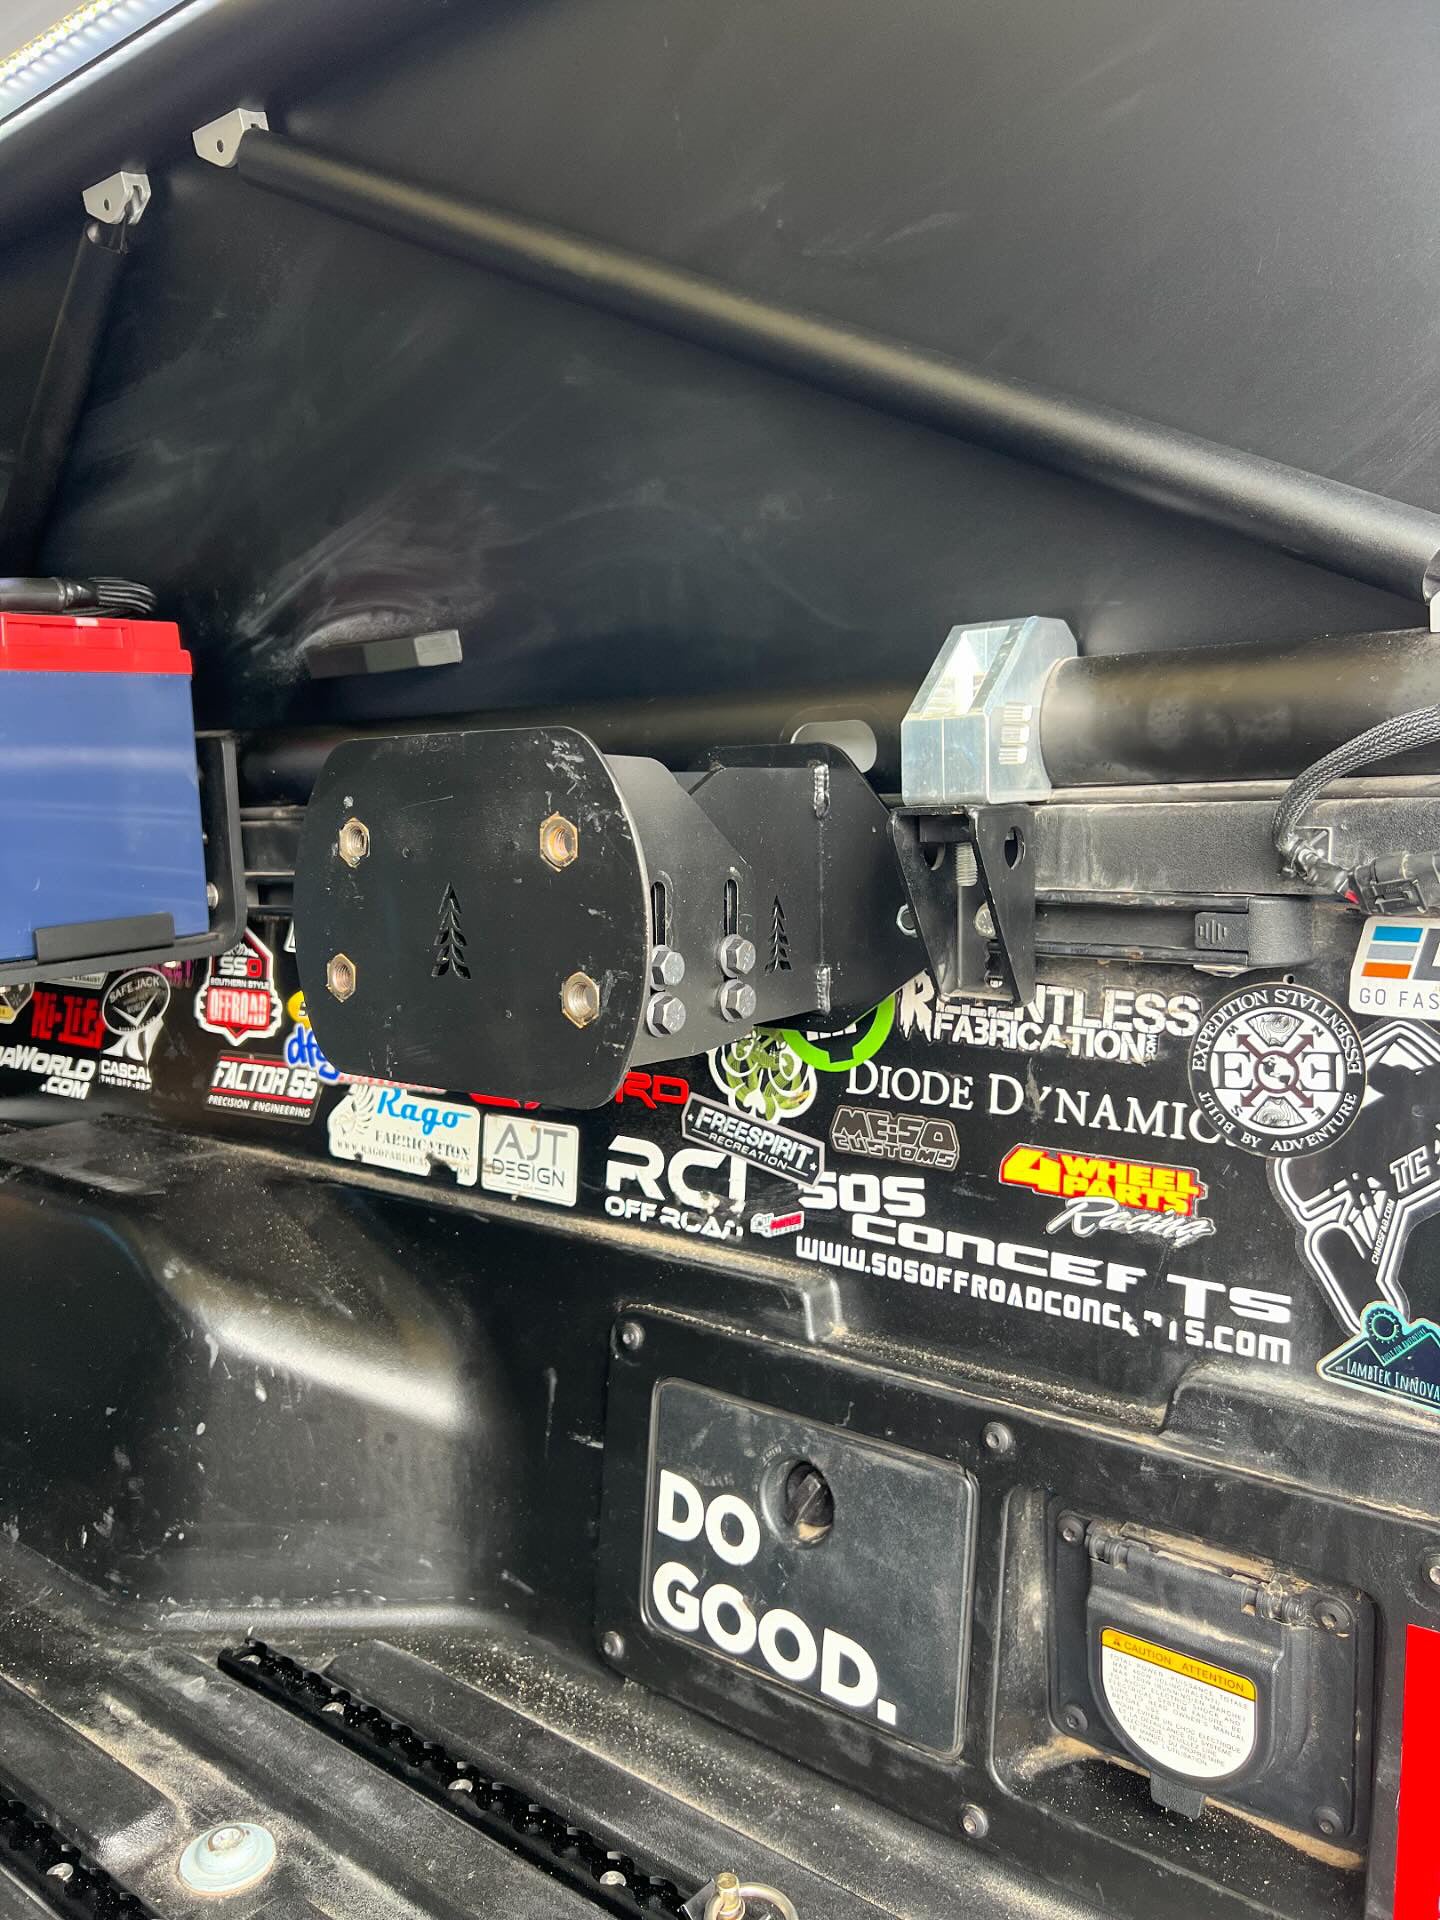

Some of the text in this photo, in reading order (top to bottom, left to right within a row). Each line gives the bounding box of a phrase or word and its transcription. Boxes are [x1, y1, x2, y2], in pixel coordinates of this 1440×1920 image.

[109, 982, 135, 1004] SAFE
[135, 976, 161, 993] JACK
[210, 977, 271, 990] SOUTHERN STYLE
[1360, 987, 1386, 1006] GO
[208, 990, 268, 1026] OFFROAD
[933, 1012, 1146, 1064] FABRICATION
[1191, 988, 1362, 1075] EXPEDITION ESSENTIALS
[0, 1045, 96, 1081] AWORLD
[211, 1061, 319, 1100] FACTOR 55
[40, 1076, 90, 1099] .COM
[208, 1094, 311, 1119] PRECISION ENGINEERING
[846, 1059, 1238, 1147] DIODE DNAMIC
[377, 1088, 471, 1136] Rago
[1198, 1091, 1357, 1152] BUILT BY ADVENTURE
[494, 1122, 568, 1168] AJT
[694, 1106, 814, 1169] FREESPIRIT
[708, 1132, 789, 1171] RECREATION
[832, 1134, 956, 1168] CUSTOMS
[492, 1157, 565, 1188] DESIGN
[1002, 1147, 1061, 1193] 4
[1059, 1152, 1201, 1195] WHEEL
[604, 1195, 658, 1223] OFF
[798, 1172, 926, 1218] SOS
[1062, 1174, 1190, 1215] PARTS
[1046, 1195, 1216, 1248] Racing
[657, 1468, 761, 1567] DO
[652, 1561, 897, 1726] GOOD.
[1123, 1640, 1244, 1693] CAUTION ATTENTION
